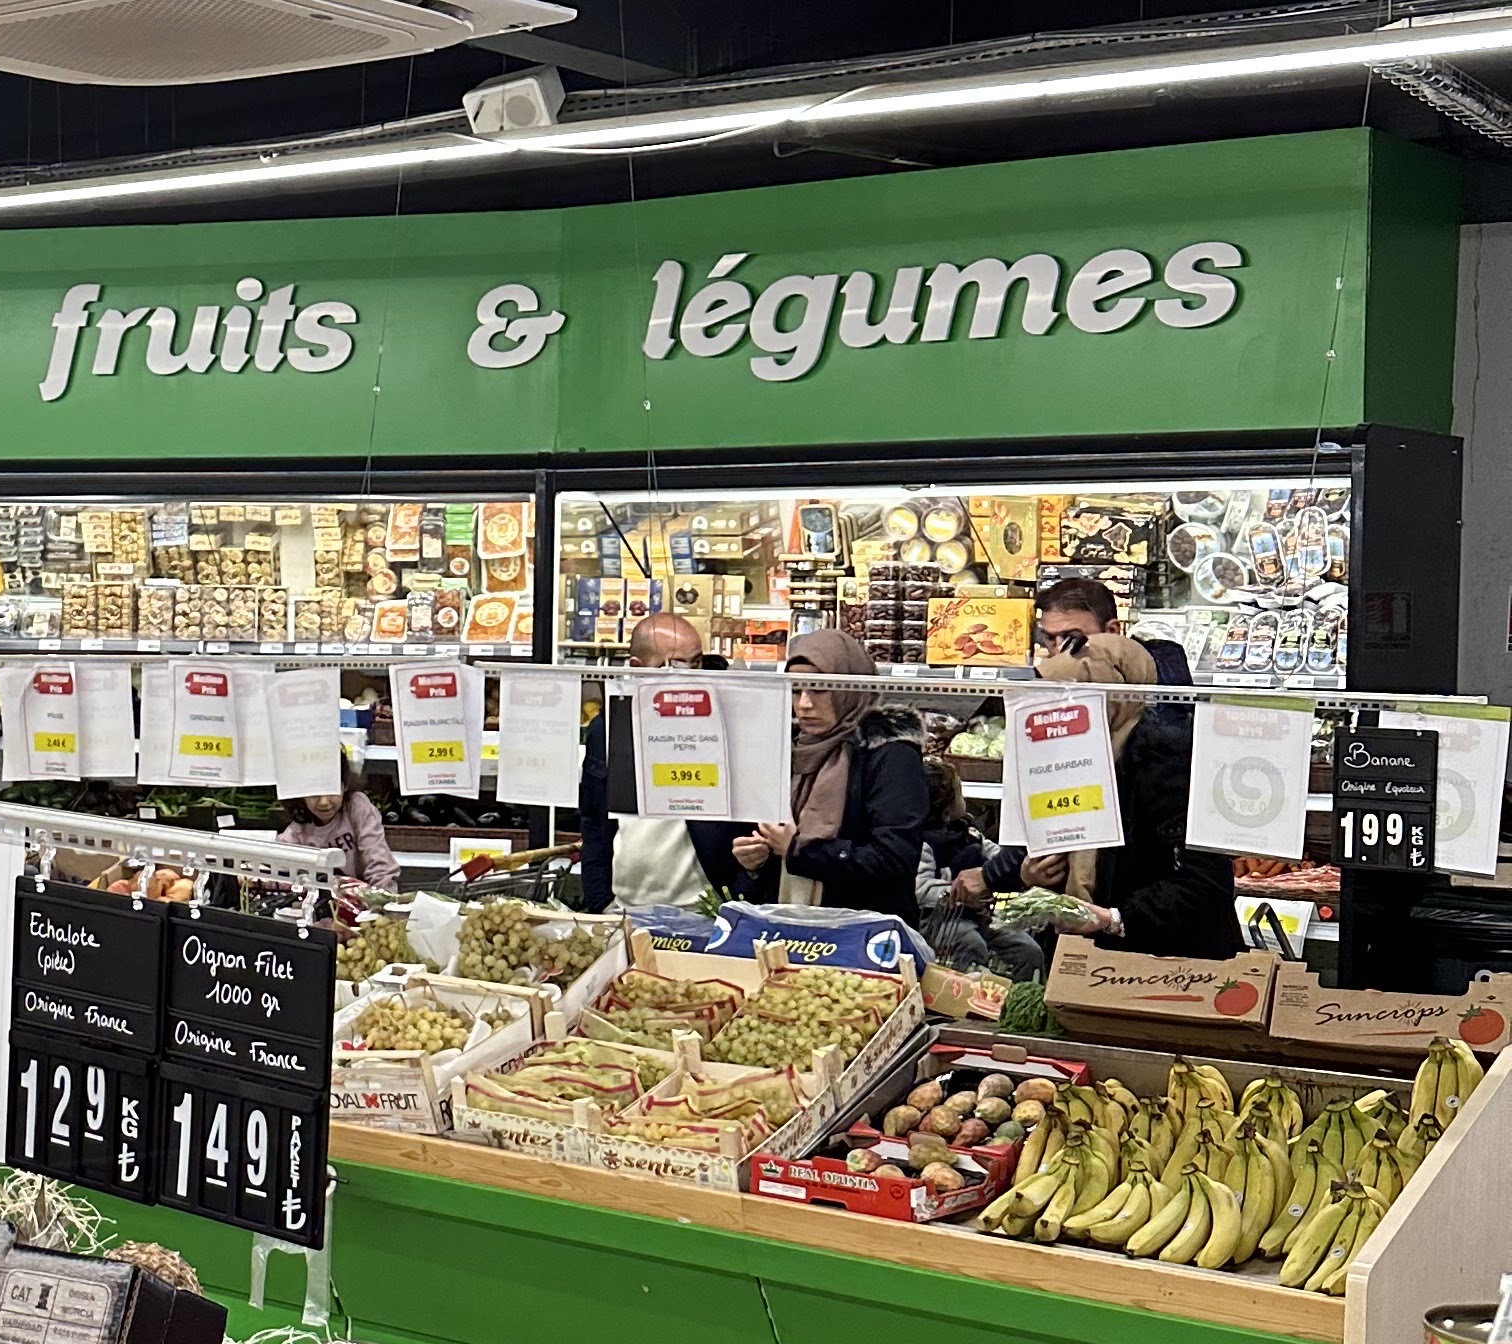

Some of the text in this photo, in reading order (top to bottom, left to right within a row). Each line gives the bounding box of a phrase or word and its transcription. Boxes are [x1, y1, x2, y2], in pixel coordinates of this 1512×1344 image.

[37, 241, 1243, 402] fruits & légumes
[962, 602, 998, 617] OASIS
[663, 692, 705, 703] Meilleur
[674, 705, 696, 716] Prix
[1033, 709, 1080, 726] Meilleur
[648, 735, 676, 743] RAISIN
[1046, 725, 1069, 738] Prix
[194, 741, 221, 752] 3,99 €
[428, 747, 455, 759] 2,99 €
[1343, 742, 1416, 768] Banane
[671, 770, 702, 782] 3,99 €
[1029, 758, 1093, 775] FIGUE BARBARI
[1341, 780, 1377, 794] Origine
[1047, 794, 1081, 811] 4,49 €
[1411, 826, 1424, 846] KG
[29, 911, 101, 948] Echalote
[182, 934, 247, 978] Oignon
[1088, 966, 1218, 990] Suncrops
[24, 991, 76, 1021] Origine
[205, 979, 281, 1017] 1000 gr
[1315, 1002, 1449, 1028] Suncrops
[174, 1020, 237, 1057] Origine
[20, 1058, 107, 1160] 129
[121, 1096, 139, 1139] KG
[330, 1092, 418, 1112] OYAL FRUIT
[173, 1092, 269, 1198] 149
[288, 1114, 303, 1189] PAKET
[622, 1156, 697, 1180] sentez
[789, 1165, 821, 1183] REAL
[821, 1171, 880, 1193] OPUNTIA
[10, 1284, 33, 1303] CAT
